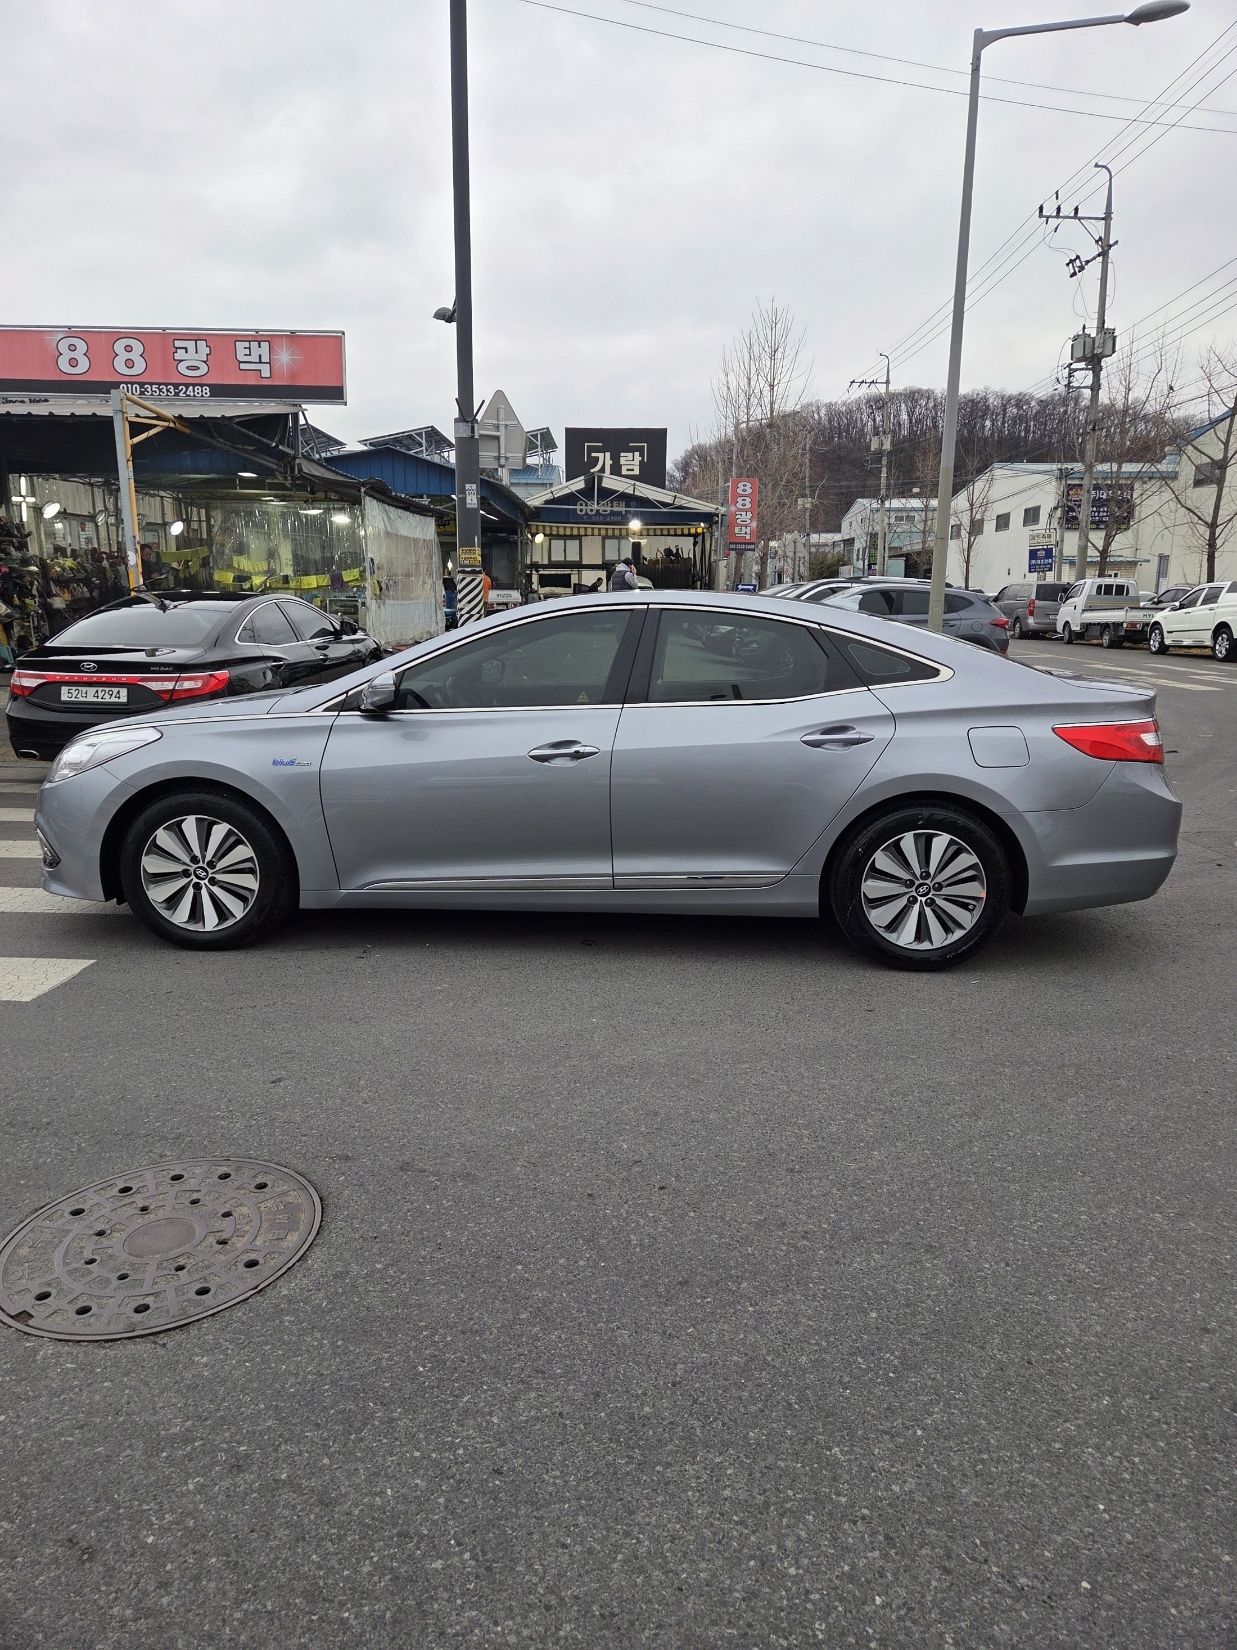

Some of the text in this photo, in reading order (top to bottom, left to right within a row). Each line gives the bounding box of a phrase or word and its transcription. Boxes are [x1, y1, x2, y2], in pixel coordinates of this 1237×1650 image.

[119, 383, 210, 397] 010-3533-2488
[589, 451, 642, 475] 가람
[735, 481, 753, 539] 88광택
[66, 688, 121, 700] 52너 4294
